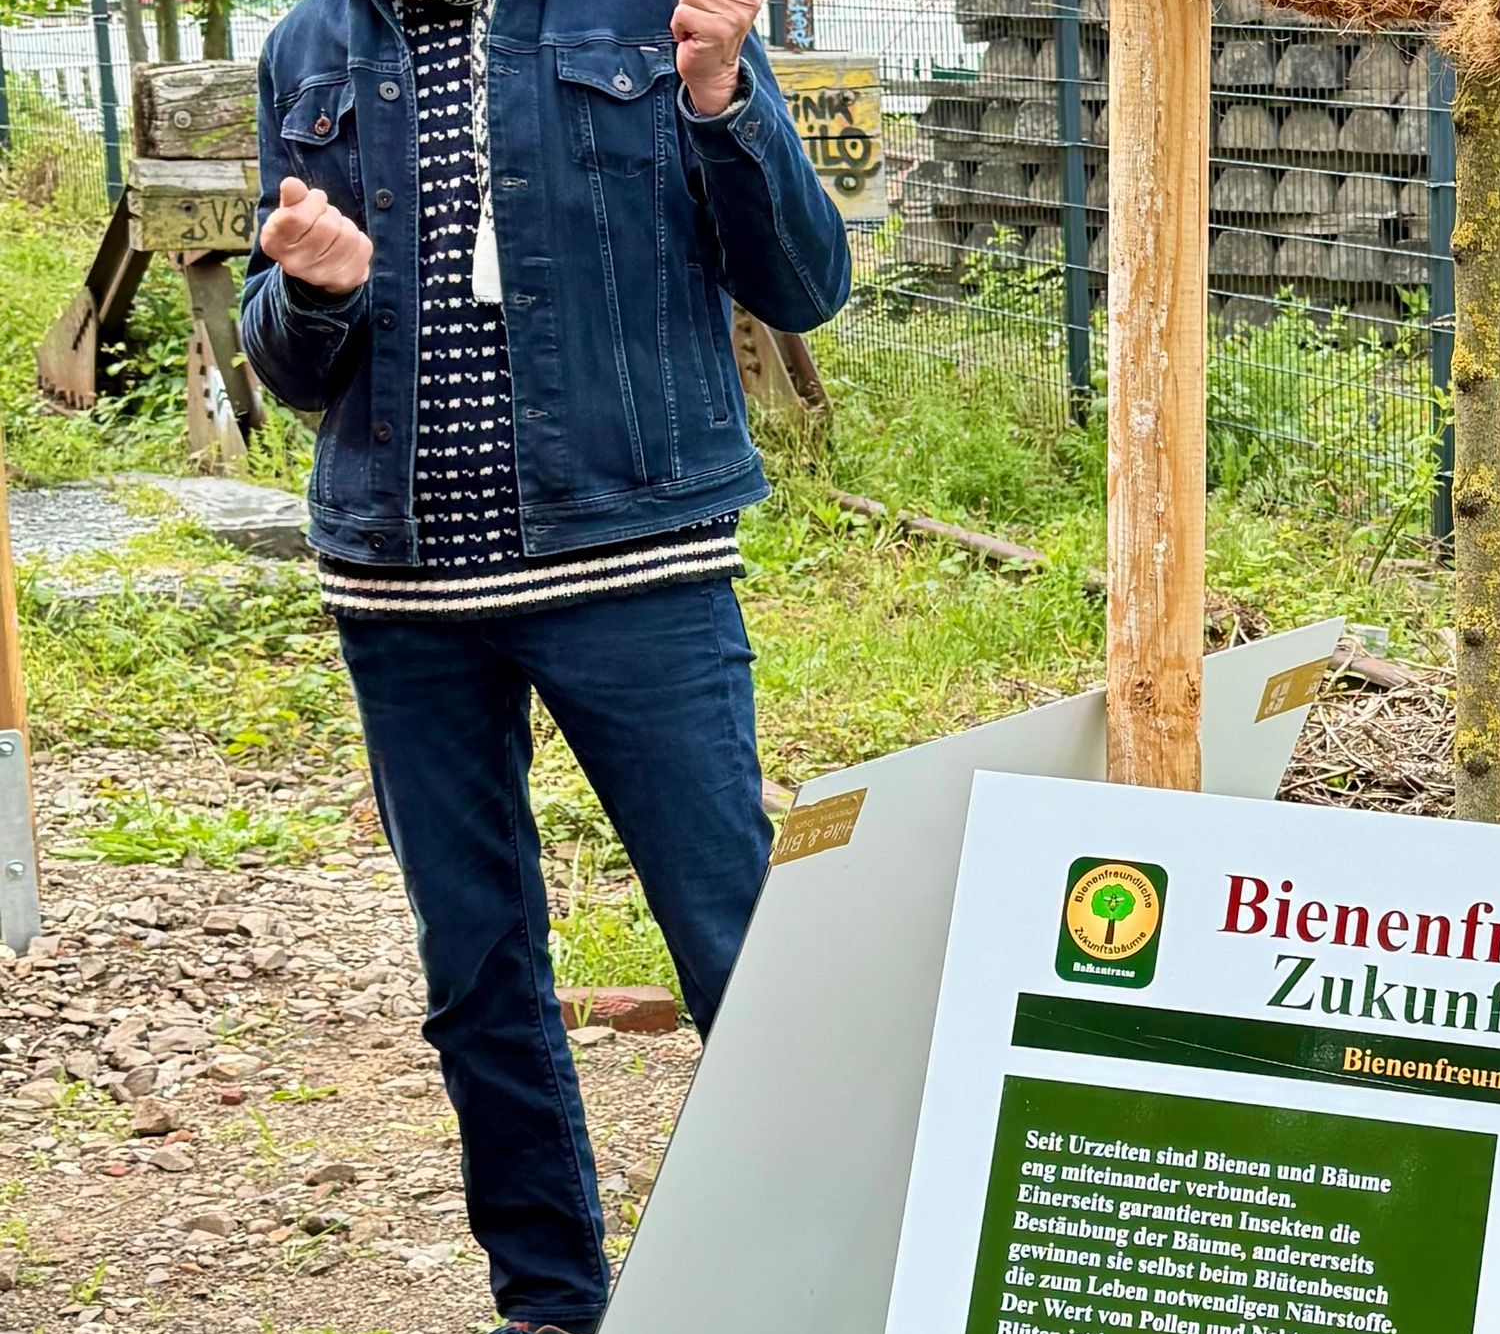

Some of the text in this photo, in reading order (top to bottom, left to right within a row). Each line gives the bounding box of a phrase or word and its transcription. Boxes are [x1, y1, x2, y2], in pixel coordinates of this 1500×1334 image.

[1074, 868, 1152, 910] Bienenfreundliche
[1073, 926, 1147, 956] Zukunftsbäume
[1021, 1161, 1297, 1209] eng miteinander verbunden.
[1025, 1130, 1392, 1194] Seit Urzeiten sind Bienen und Bäume
[1013, 1210, 1375, 1275] Bestäubung der Bäume, andererseits
[1017, 1183, 1361, 1245] Einerseits garantieren Insekten die
[1005, 1265, 1397, 1334] die zum Leben notwendigen Nährstoffe.
[1007, 1242, 1389, 1306] gewinnen sie selbst beim Blütenbesuch
[999, 1292, 1039, 1315] Der
[1043, 1297, 1094, 1322] Wert
[1097, 1309, 1133, 1328] von
